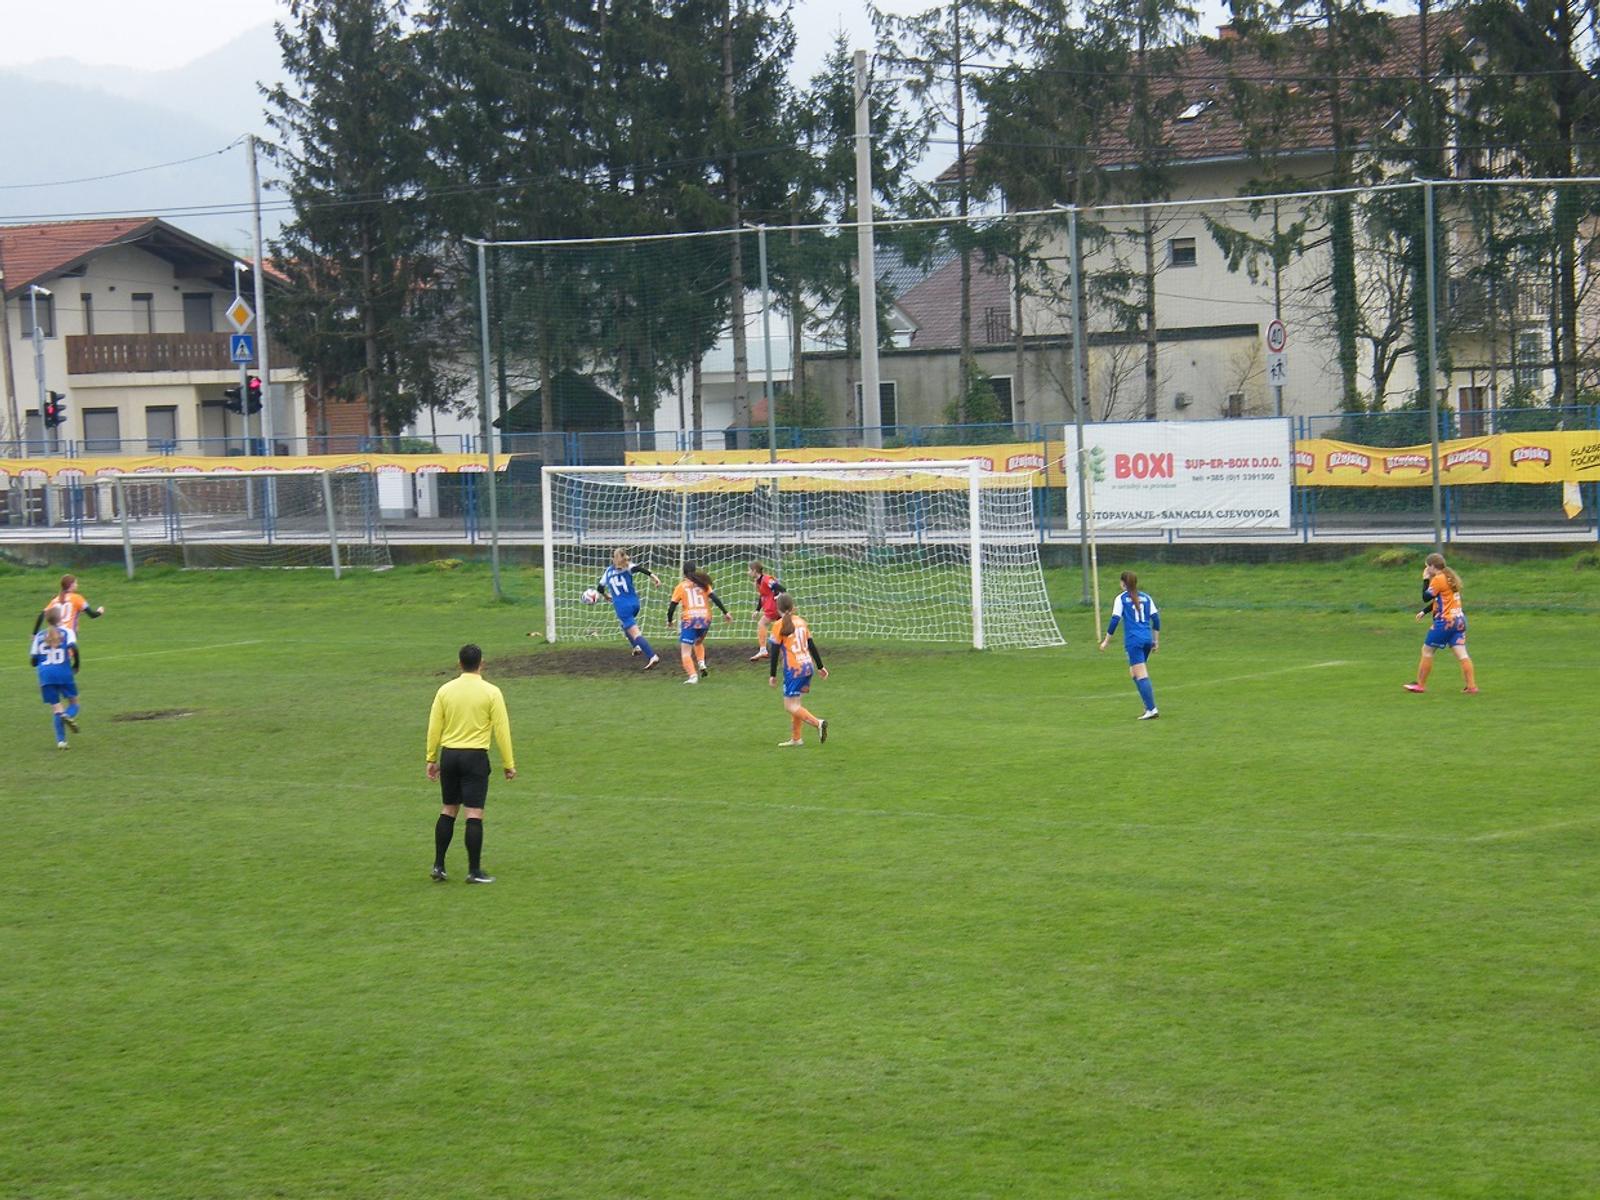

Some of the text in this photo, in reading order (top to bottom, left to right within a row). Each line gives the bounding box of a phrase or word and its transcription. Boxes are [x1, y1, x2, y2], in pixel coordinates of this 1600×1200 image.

[1271, 328, 1283, 345] 40
[1114, 452, 1174, 479] BOXI
[1251, 457, 1282, 468] D.O.O.
[1216, 509, 1280, 519] CJEVOVODA
[609, 574, 629, 596] 14
[685, 586, 705, 608] 16
[1131, 603, 1145, 623] 11
